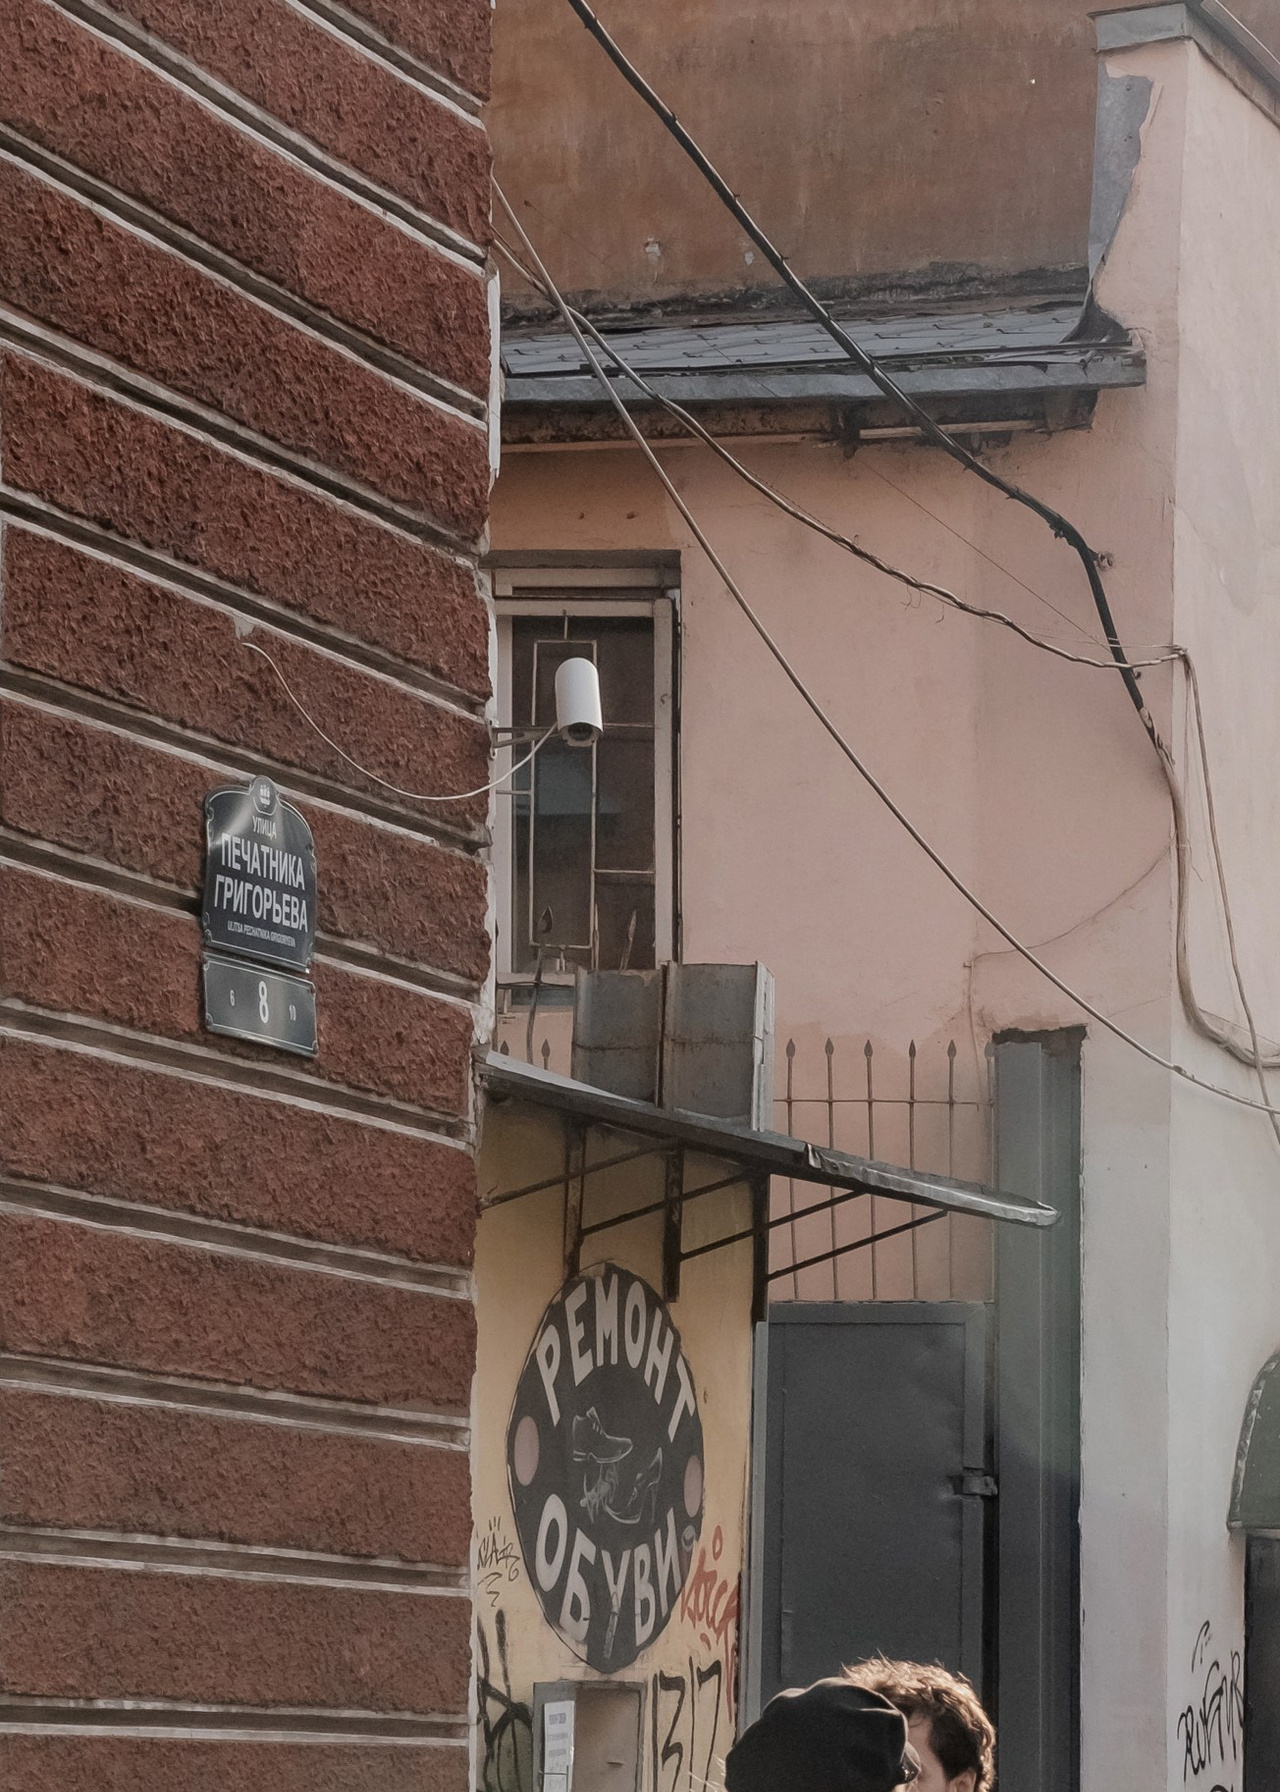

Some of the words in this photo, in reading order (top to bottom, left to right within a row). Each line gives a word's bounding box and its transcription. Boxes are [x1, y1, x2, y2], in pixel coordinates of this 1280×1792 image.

[252, 815, 277, 840] УЛИЦА
[221, 832, 306, 891] ПЕЧАТНИКА
[213, 873, 308, 933] ГРИГОРЬЕВА
[258, 981, 270, 1024] 8
[535, 1272, 697, 1444] РЕМОНТ
[535, 1493, 683, 1660] ОБУВИ
